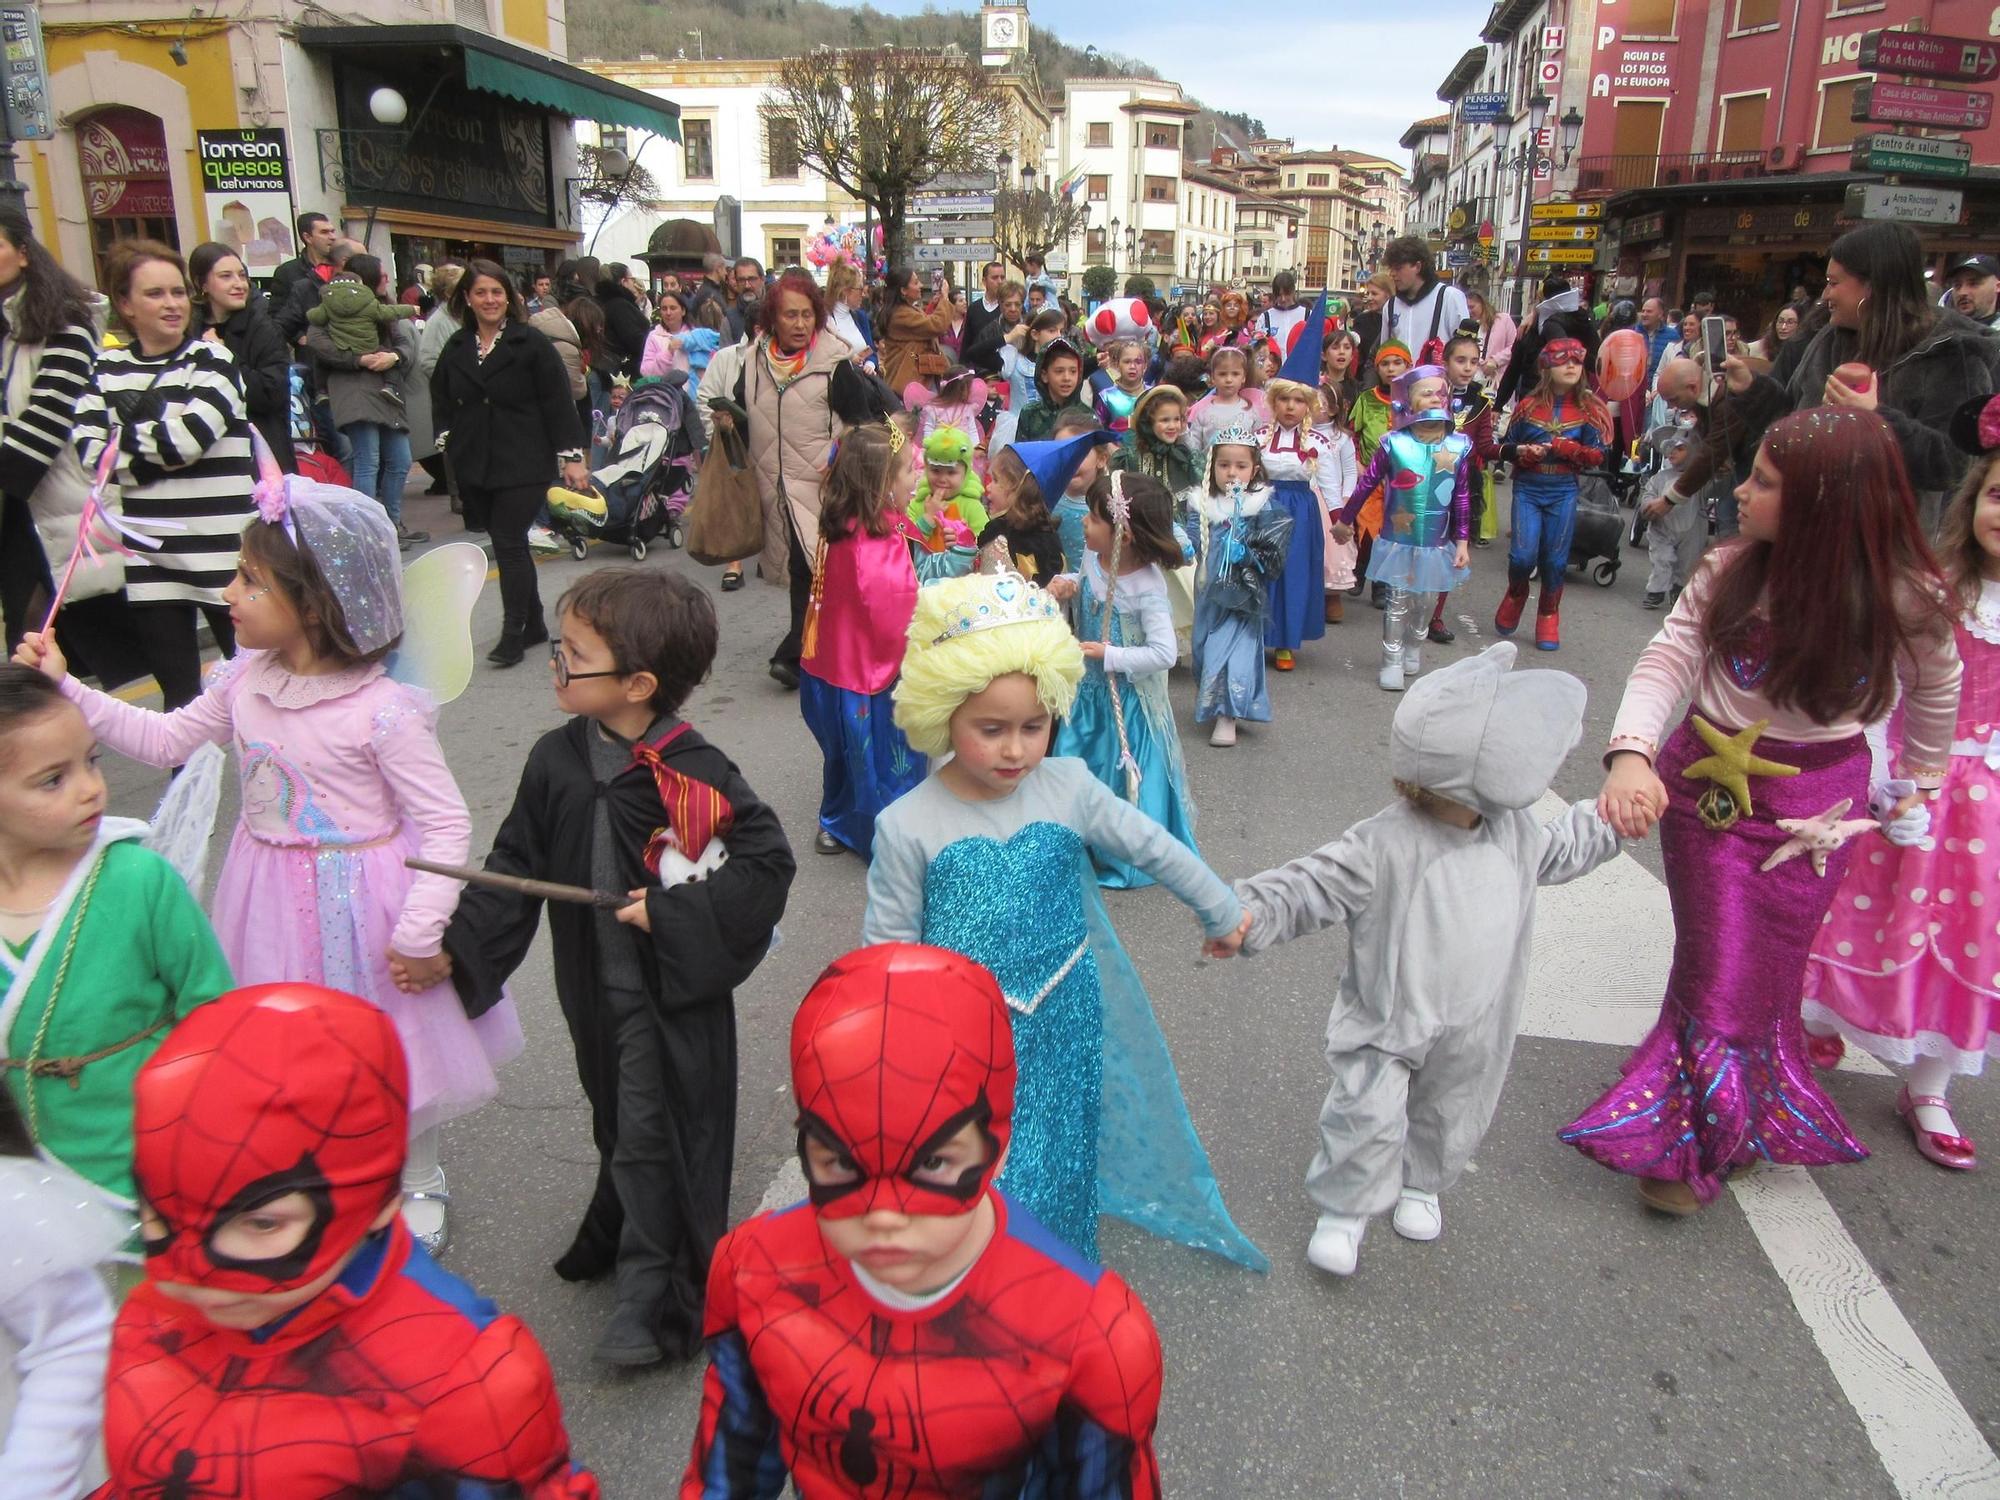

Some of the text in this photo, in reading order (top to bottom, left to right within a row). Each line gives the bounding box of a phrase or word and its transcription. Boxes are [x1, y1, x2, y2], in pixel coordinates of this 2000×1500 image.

[1881, 37, 1945, 55] Aula del Reino
[1623, 51, 1666, 61] AGUA DE
[1879, 52, 1936, 70] de Asturias
[1620, 63, 1668, 75] LOS PICOS
[1614, 76, 1671, 87] DE EUROPA
[1880, 87, 1899, 98] Casa
[1902, 88, 1911, 98] de
[1904, 108, 1914, 119] de
[200, 136, 281, 159] torreon
[1875, 137, 1941, 154] centro de salud
[204, 161, 283, 190] quesos
[220, 176, 284, 190] asturianos
[969, 246, 991, 255] Local
